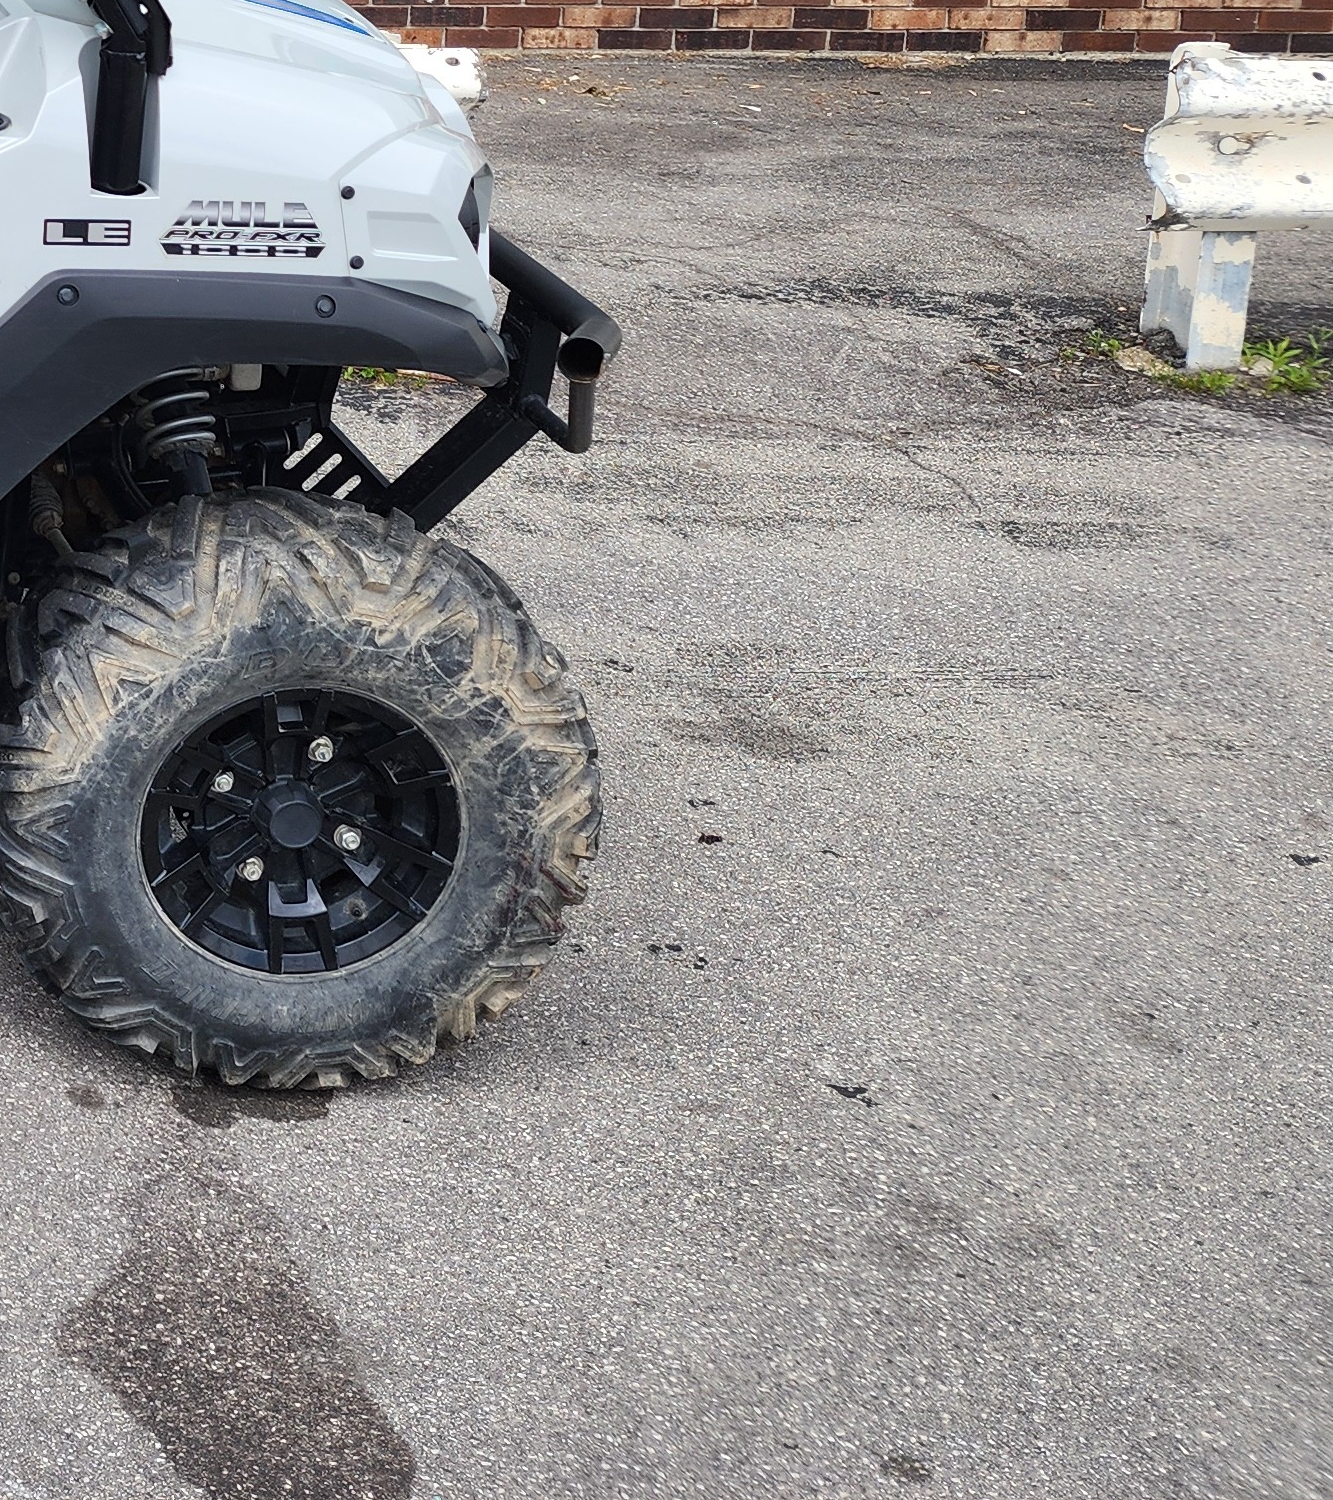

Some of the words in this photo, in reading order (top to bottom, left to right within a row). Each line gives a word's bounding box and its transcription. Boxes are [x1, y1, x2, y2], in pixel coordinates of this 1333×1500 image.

[173, 200, 320, 229] MULE
[45, 221, 130, 243] LE
[159, 228, 325, 243] PRO-FXR
